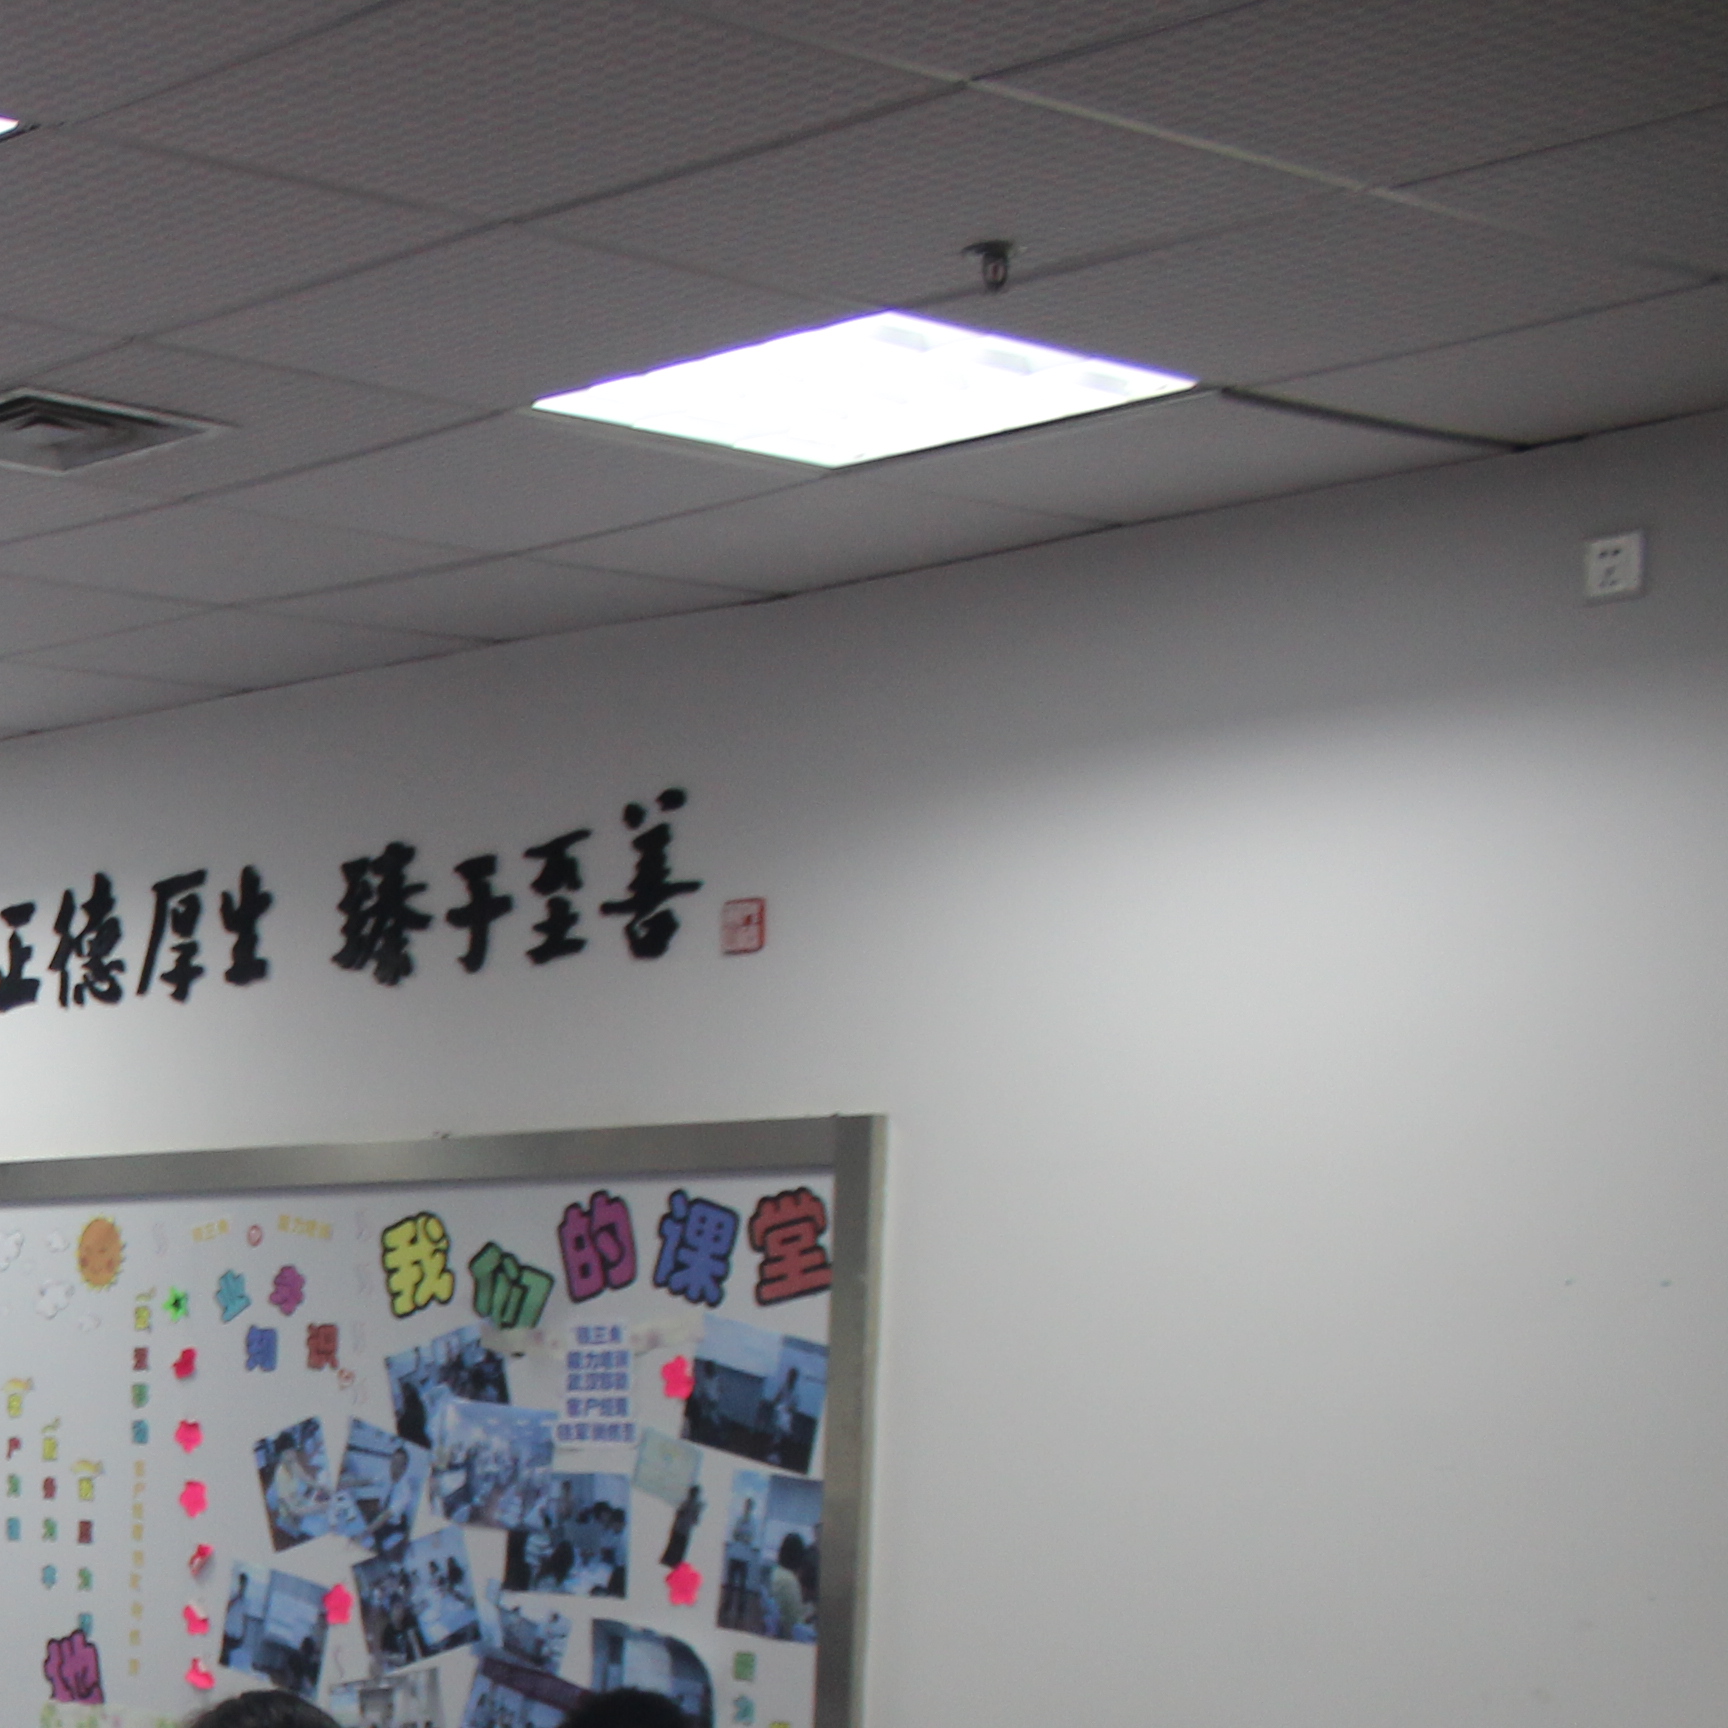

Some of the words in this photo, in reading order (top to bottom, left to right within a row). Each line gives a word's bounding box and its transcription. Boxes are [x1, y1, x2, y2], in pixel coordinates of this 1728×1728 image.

[381, 1186, 833, 1331] 我们的课堂
